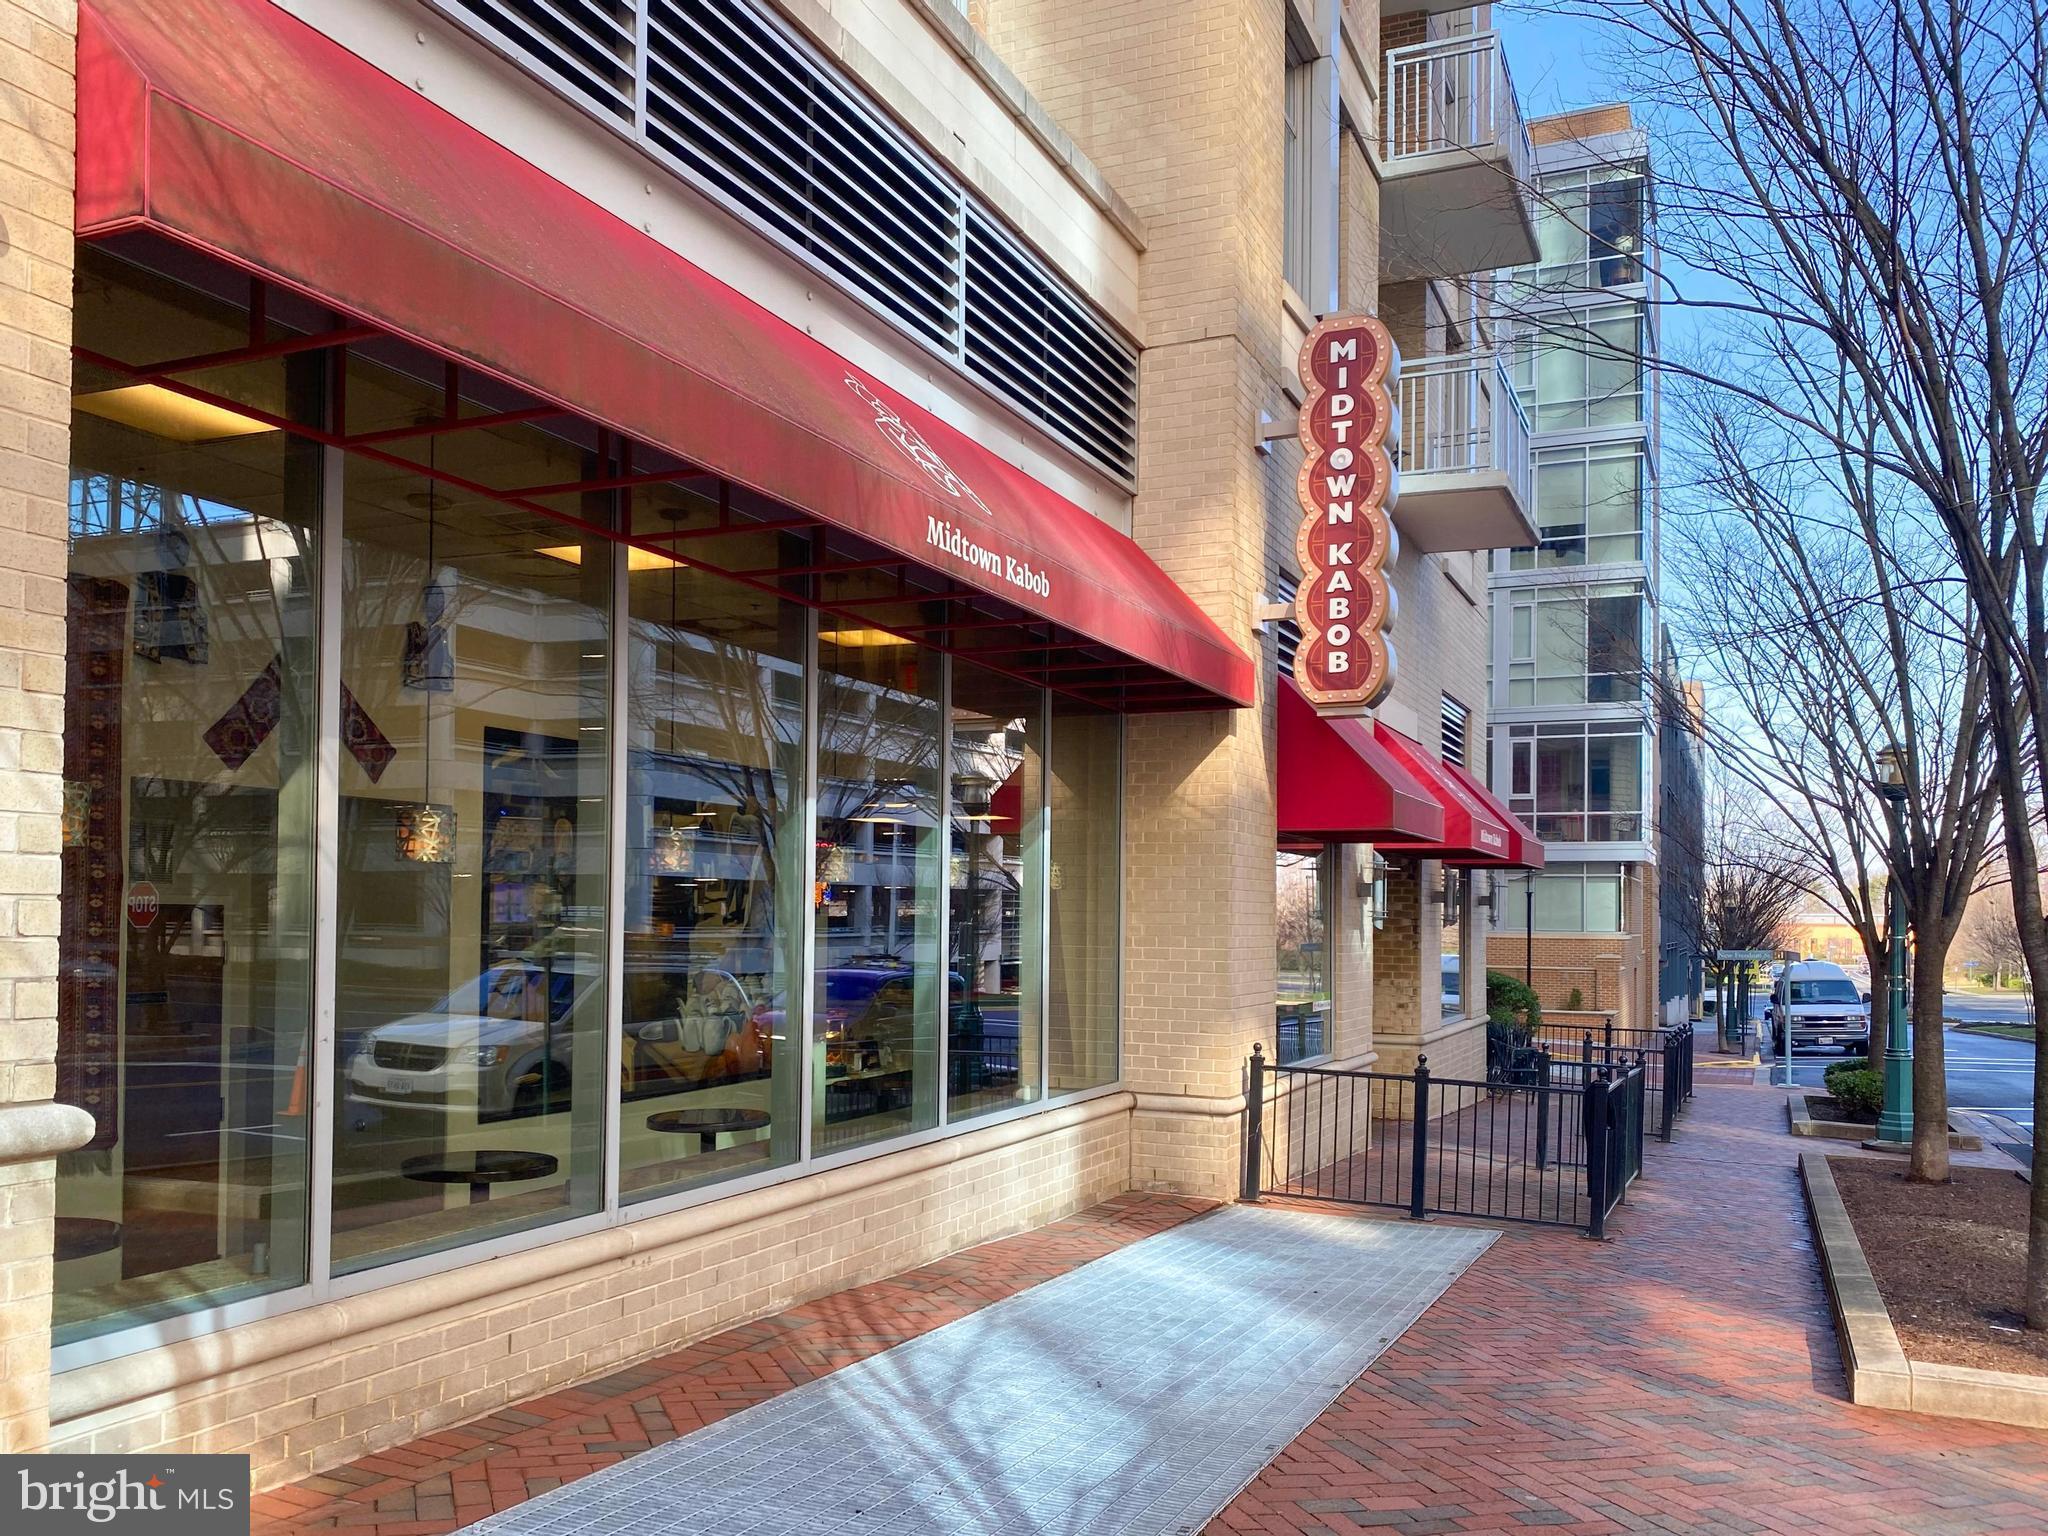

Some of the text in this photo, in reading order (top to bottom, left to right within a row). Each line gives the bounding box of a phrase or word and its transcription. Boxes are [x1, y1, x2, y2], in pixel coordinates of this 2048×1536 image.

[926, 515, 1050, 598] Midtown Kabob
[1326, 338, 1358, 674] MIDTOWN KABOB
